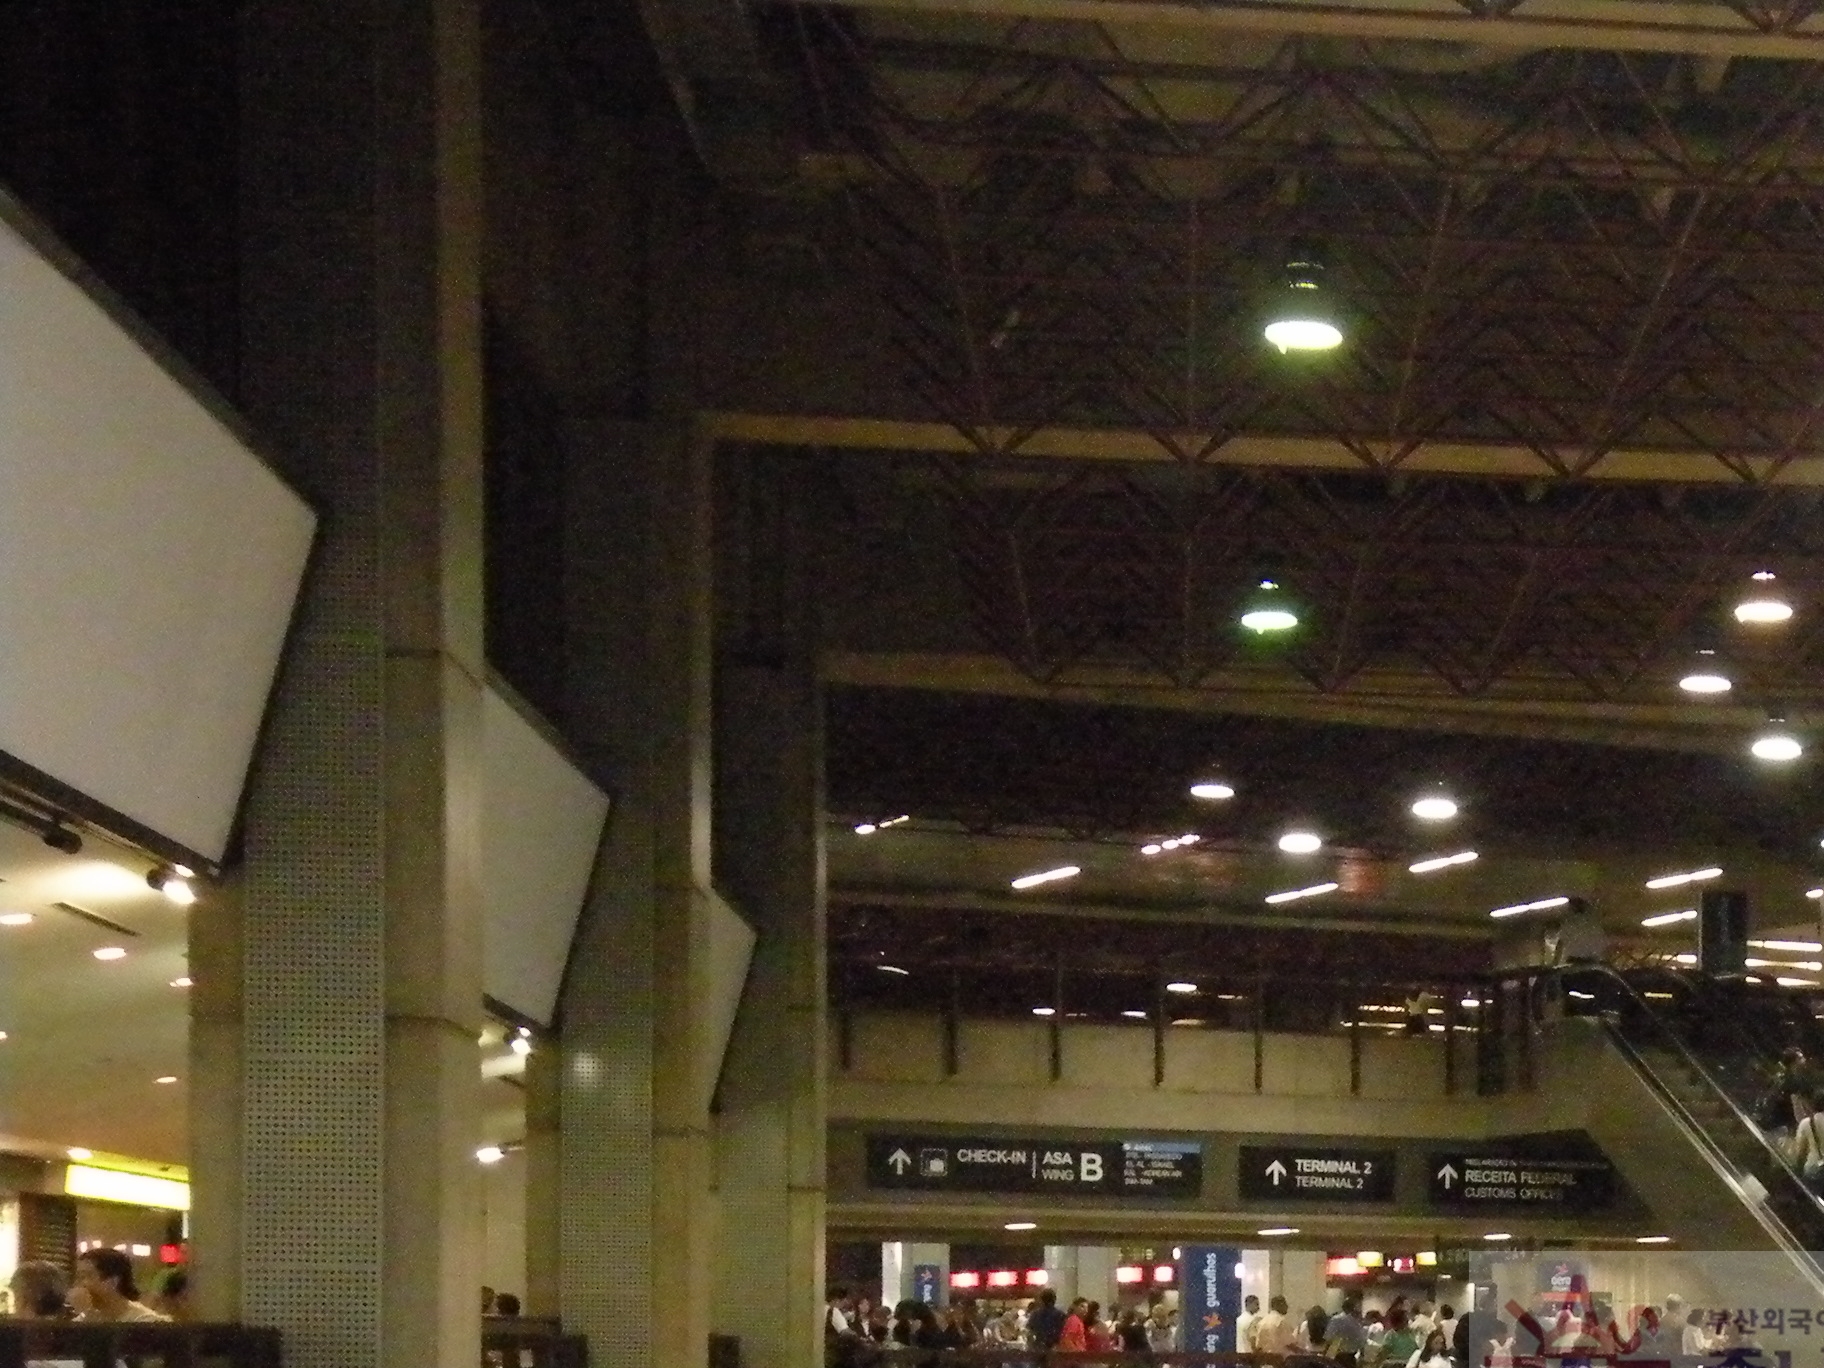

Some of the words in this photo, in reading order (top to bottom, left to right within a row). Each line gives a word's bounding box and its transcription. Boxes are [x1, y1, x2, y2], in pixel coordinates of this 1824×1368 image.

[957, 1148, 1026, 1164] CHECK-IN
[1043, 1151, 1072, 1165] ASA
[1080, 1153, 1104, 1182] B
[1294, 1158, 1358, 1176] TERMINAL
[1360, 1161, 1373, 1176] 2
[1042, 1169, 1074, 1181] WING
[1294, 1175, 1355, 1189] TERMINAL
[1356, 1177, 1363, 1189] 2
[1465, 1170, 1517, 1184] RECEITA
[1465, 1188, 1516, 1198] CUSTOMS
